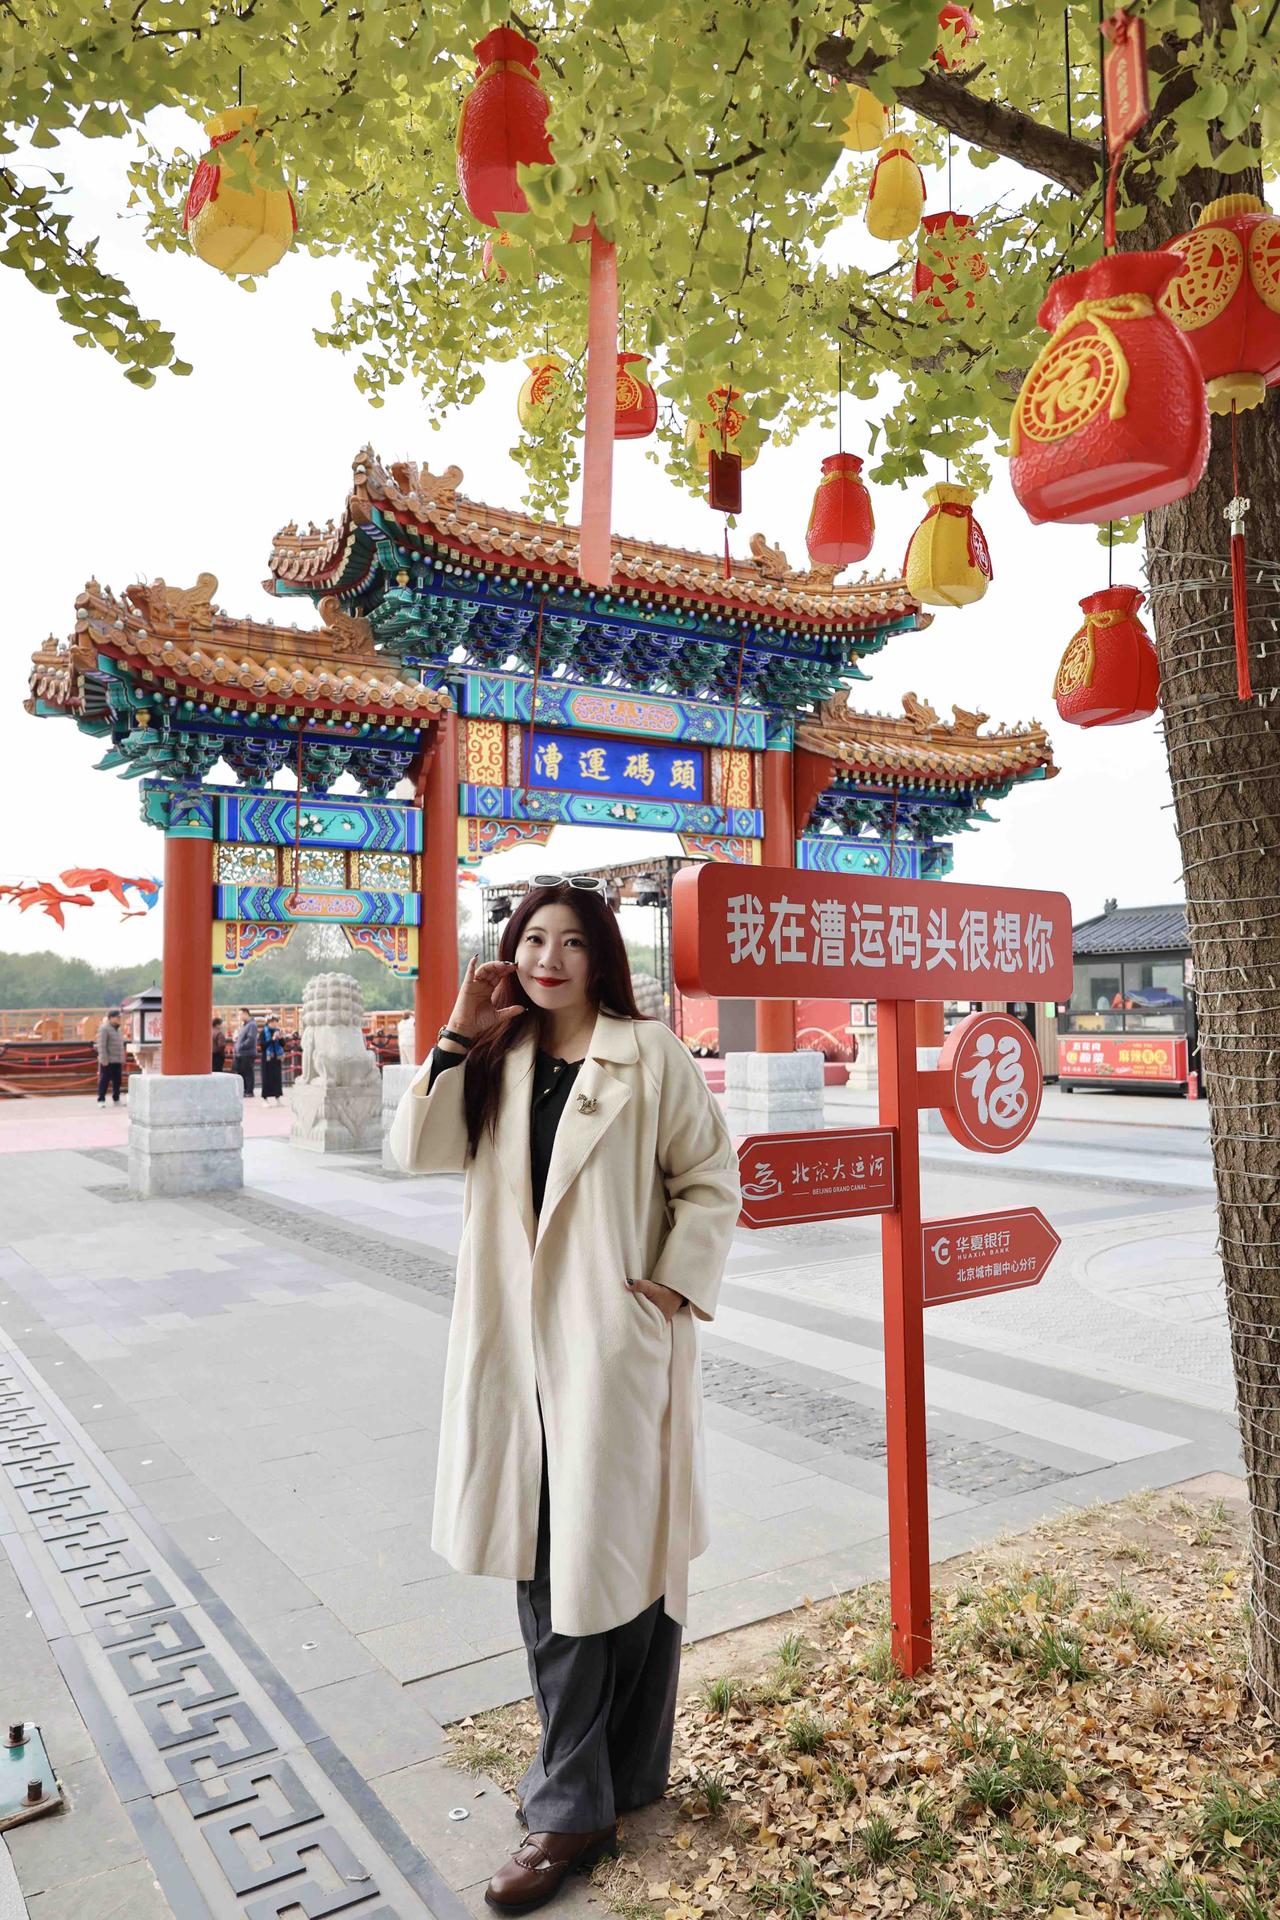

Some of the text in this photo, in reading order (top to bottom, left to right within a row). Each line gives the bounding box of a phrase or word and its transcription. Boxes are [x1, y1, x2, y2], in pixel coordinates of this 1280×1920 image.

[1035, 350, 1098, 426] 福
[534, 742, 696, 791] 漕運碼頭
[726, 893, 1054, 974] 我在漕运码头很想你
[960, 1033, 1029, 1129] 福
[792, 1154, 885, 1184] 北京大运河
[812, 1184, 867, 1196] BEIJING GRAND CANAL
[956, 1230, 1010, 1253] 华夏银行
[957, 1248, 1010, 1261] HUAXIA BANK
[957, 1257, 1037, 1283] 北京城市副中心分行
